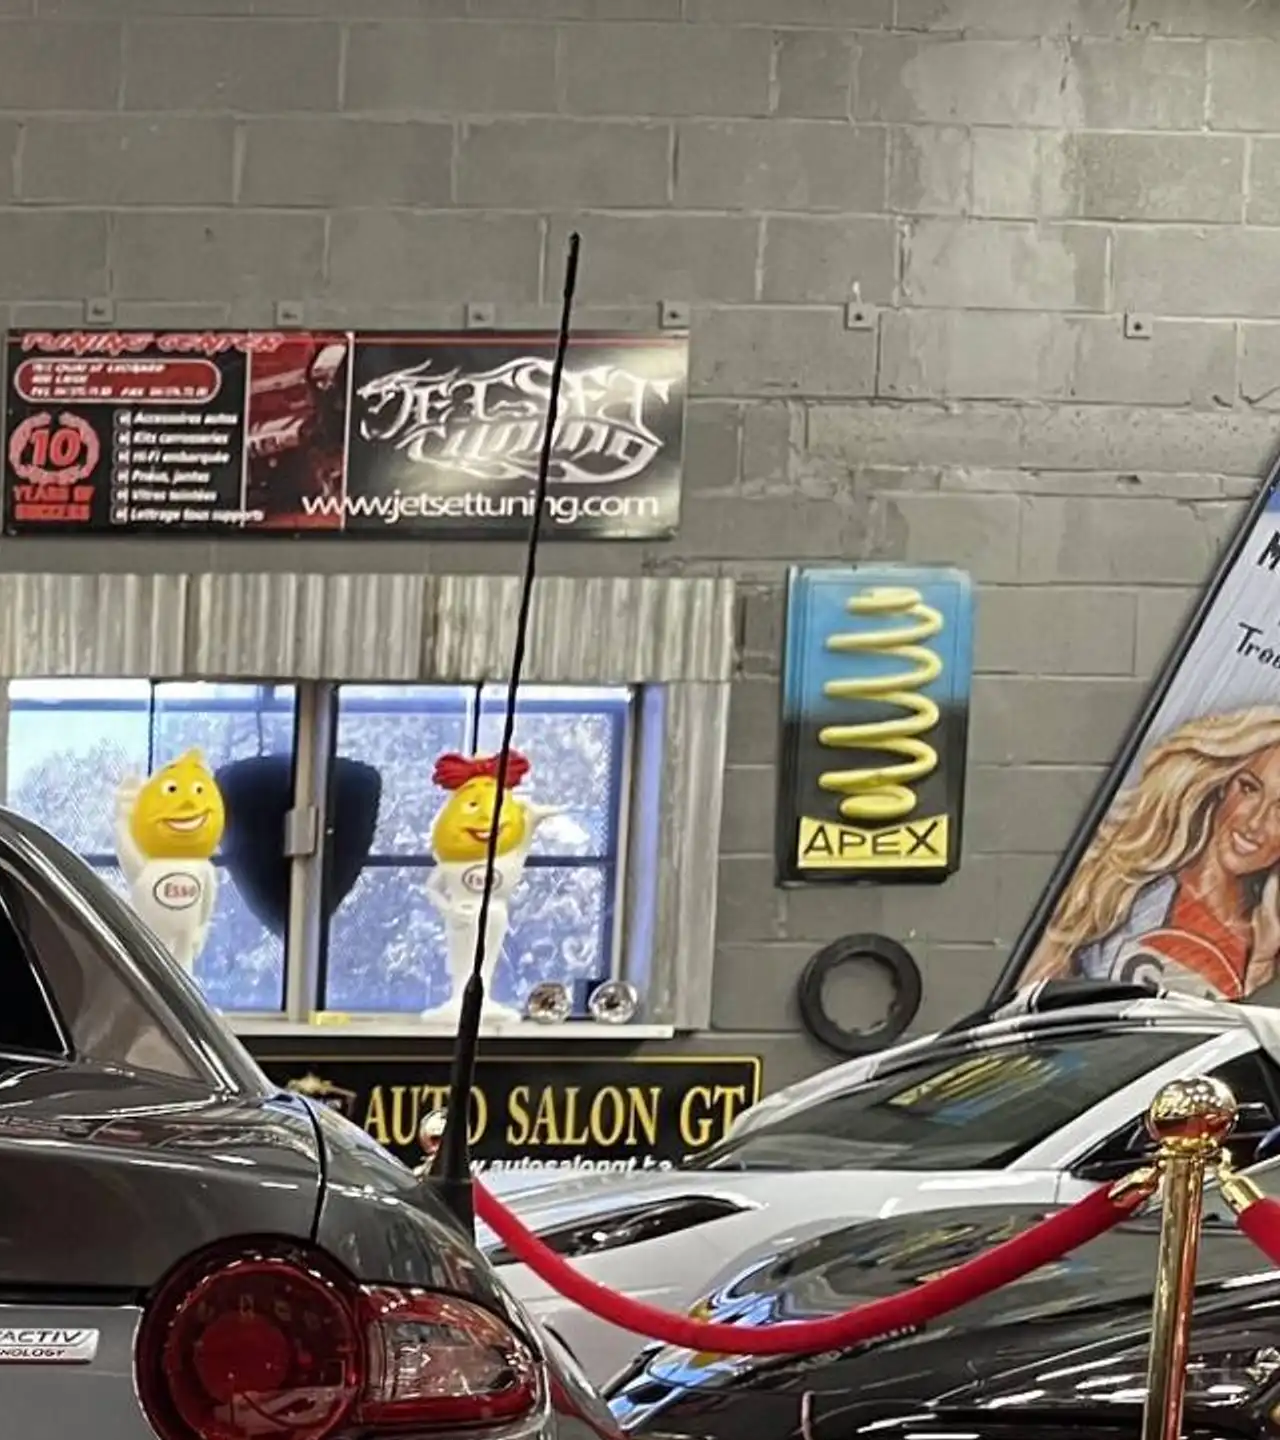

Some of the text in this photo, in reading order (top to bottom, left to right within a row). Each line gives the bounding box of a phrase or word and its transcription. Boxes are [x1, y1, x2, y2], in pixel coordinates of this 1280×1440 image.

[133, 411, 238, 424] Accessoires autos
[30, 428, 83, 465] 10
[133, 431, 157, 444] Kits
[130, 507, 264, 524] Lettrage tous supports
[301, 488, 659, 524] www.jetsettuning.com
[802, 820, 939, 856] APEX
[163, 881, 198, 899] Esso
[365, 1084, 746, 1147] AUTO SALON GT
